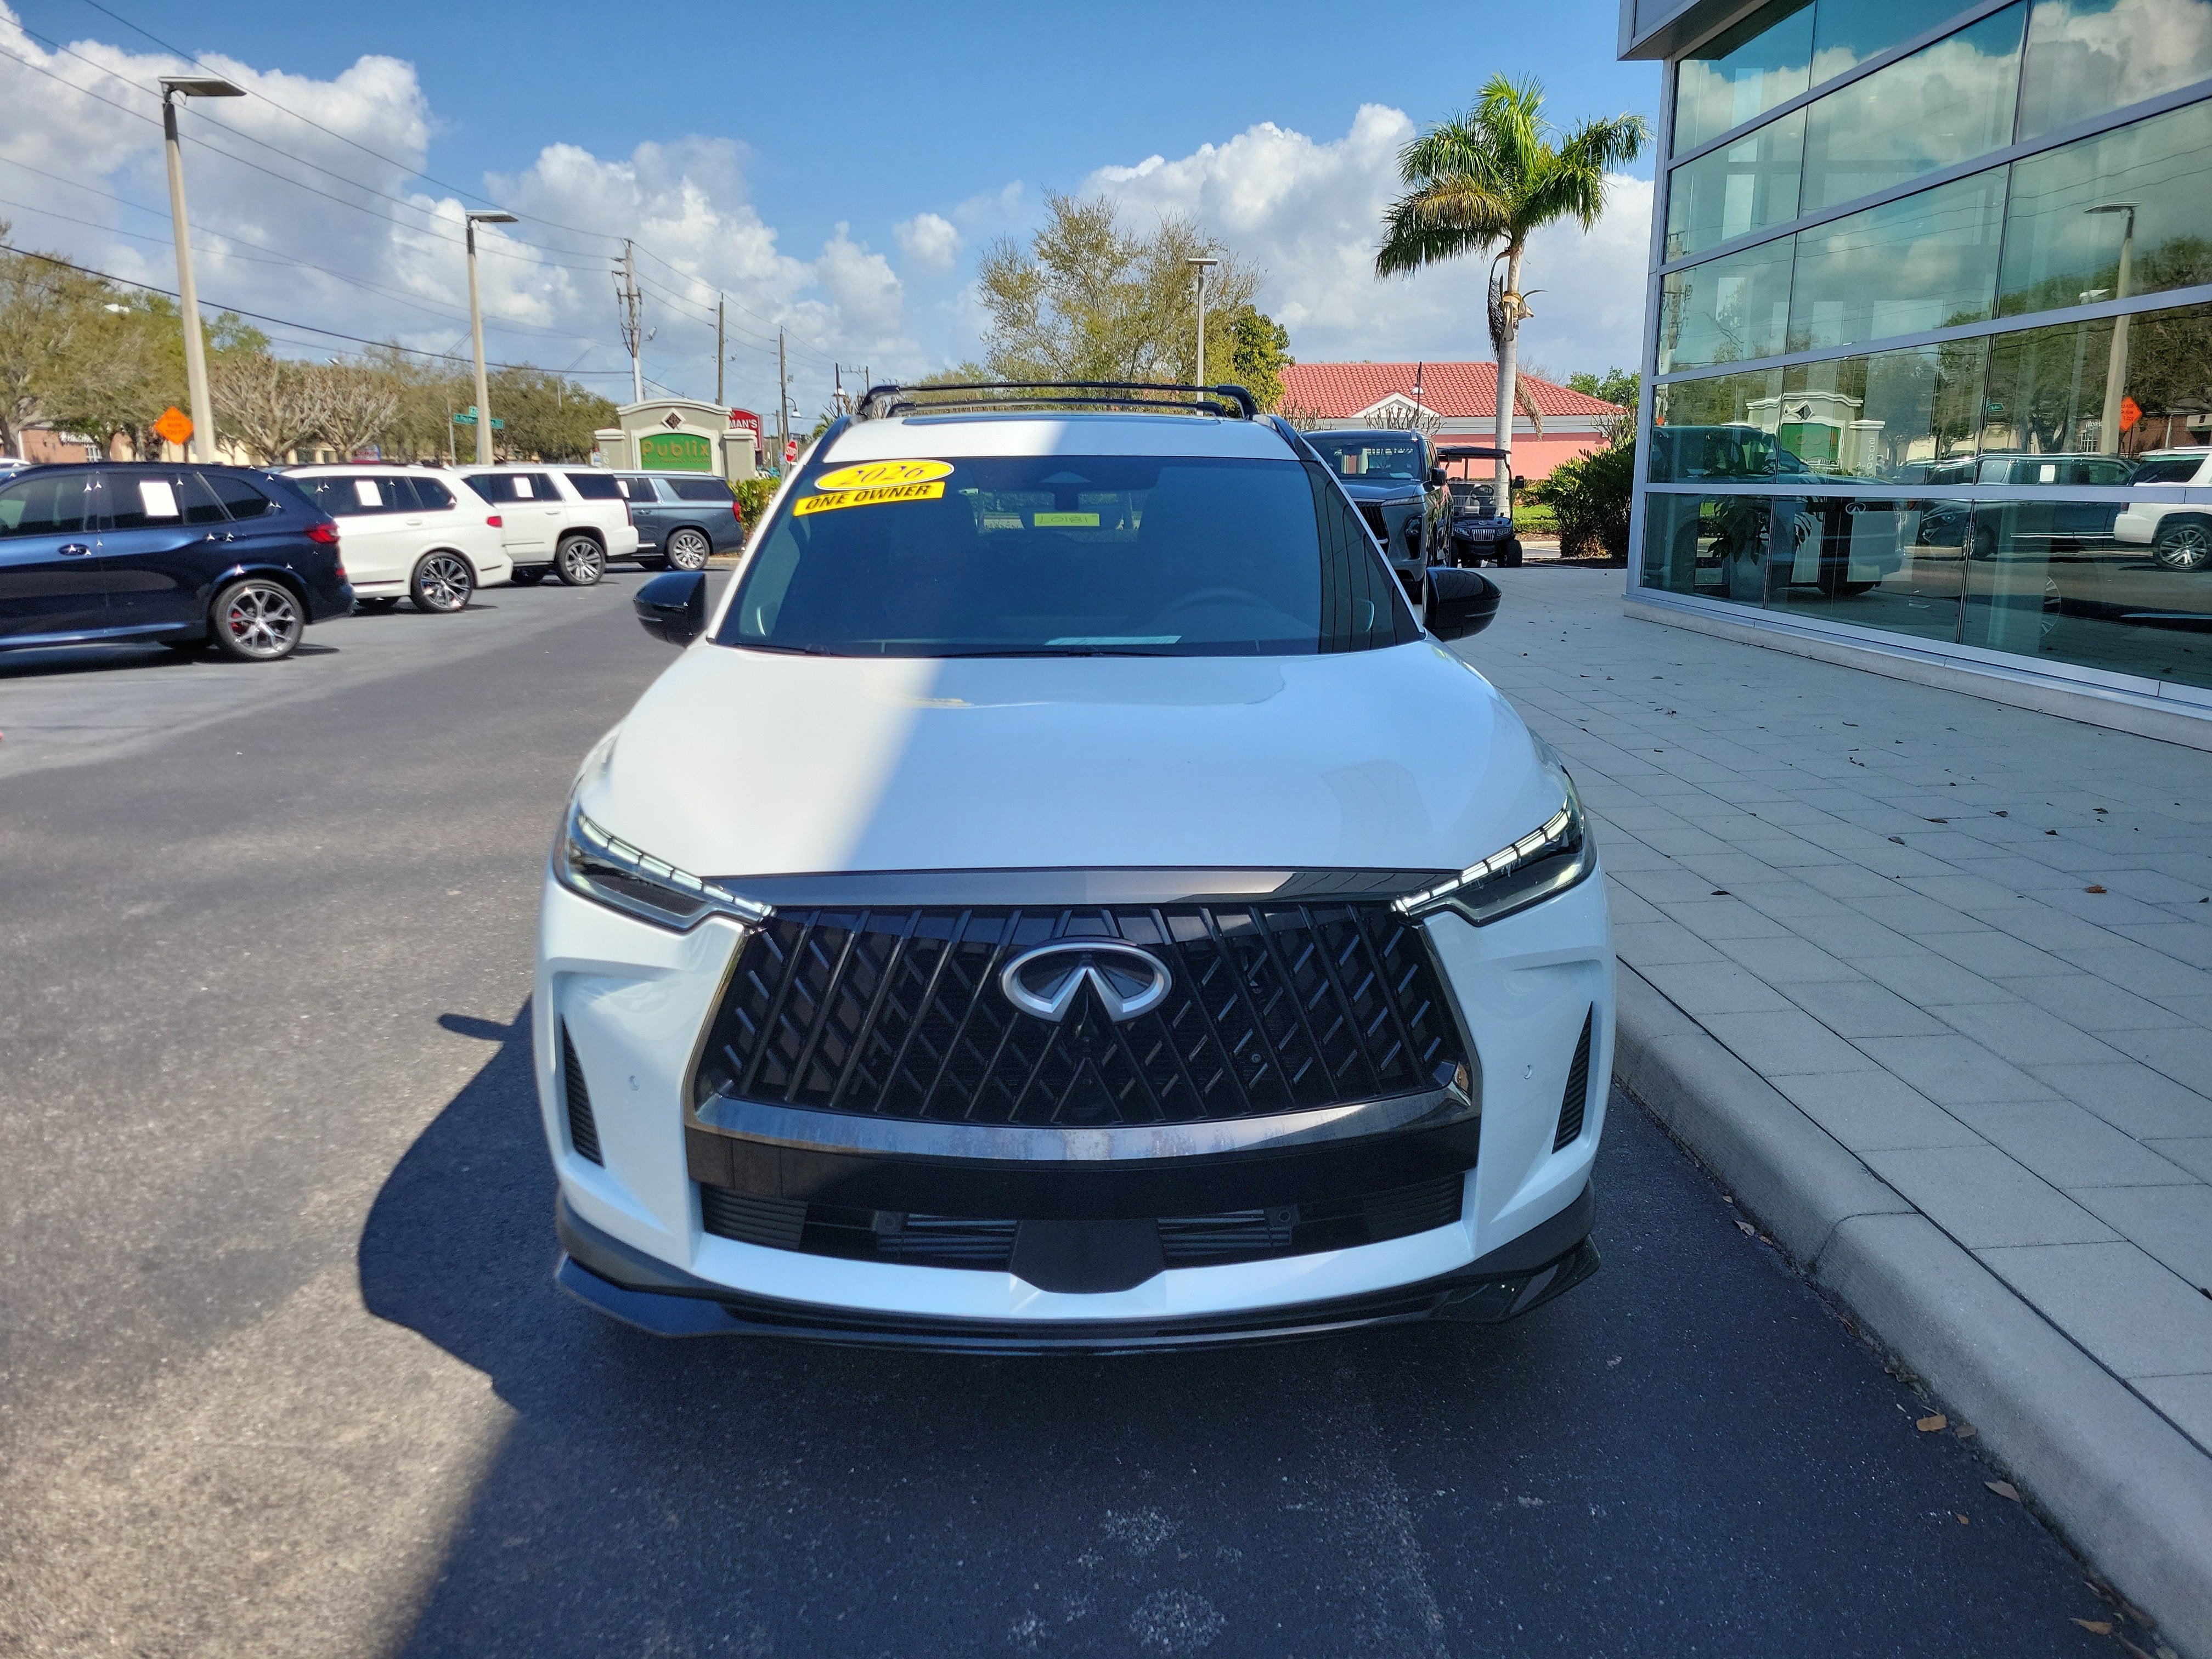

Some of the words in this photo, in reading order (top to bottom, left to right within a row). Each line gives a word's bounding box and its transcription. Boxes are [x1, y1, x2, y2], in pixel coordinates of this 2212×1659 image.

[729, 419, 758, 429] MAN'S
[641, 439, 709, 458] Publix
[838, 465, 926, 487] 2026
[805, 494, 848, 510] ONE
[854, 484, 932, 501] OWNER
